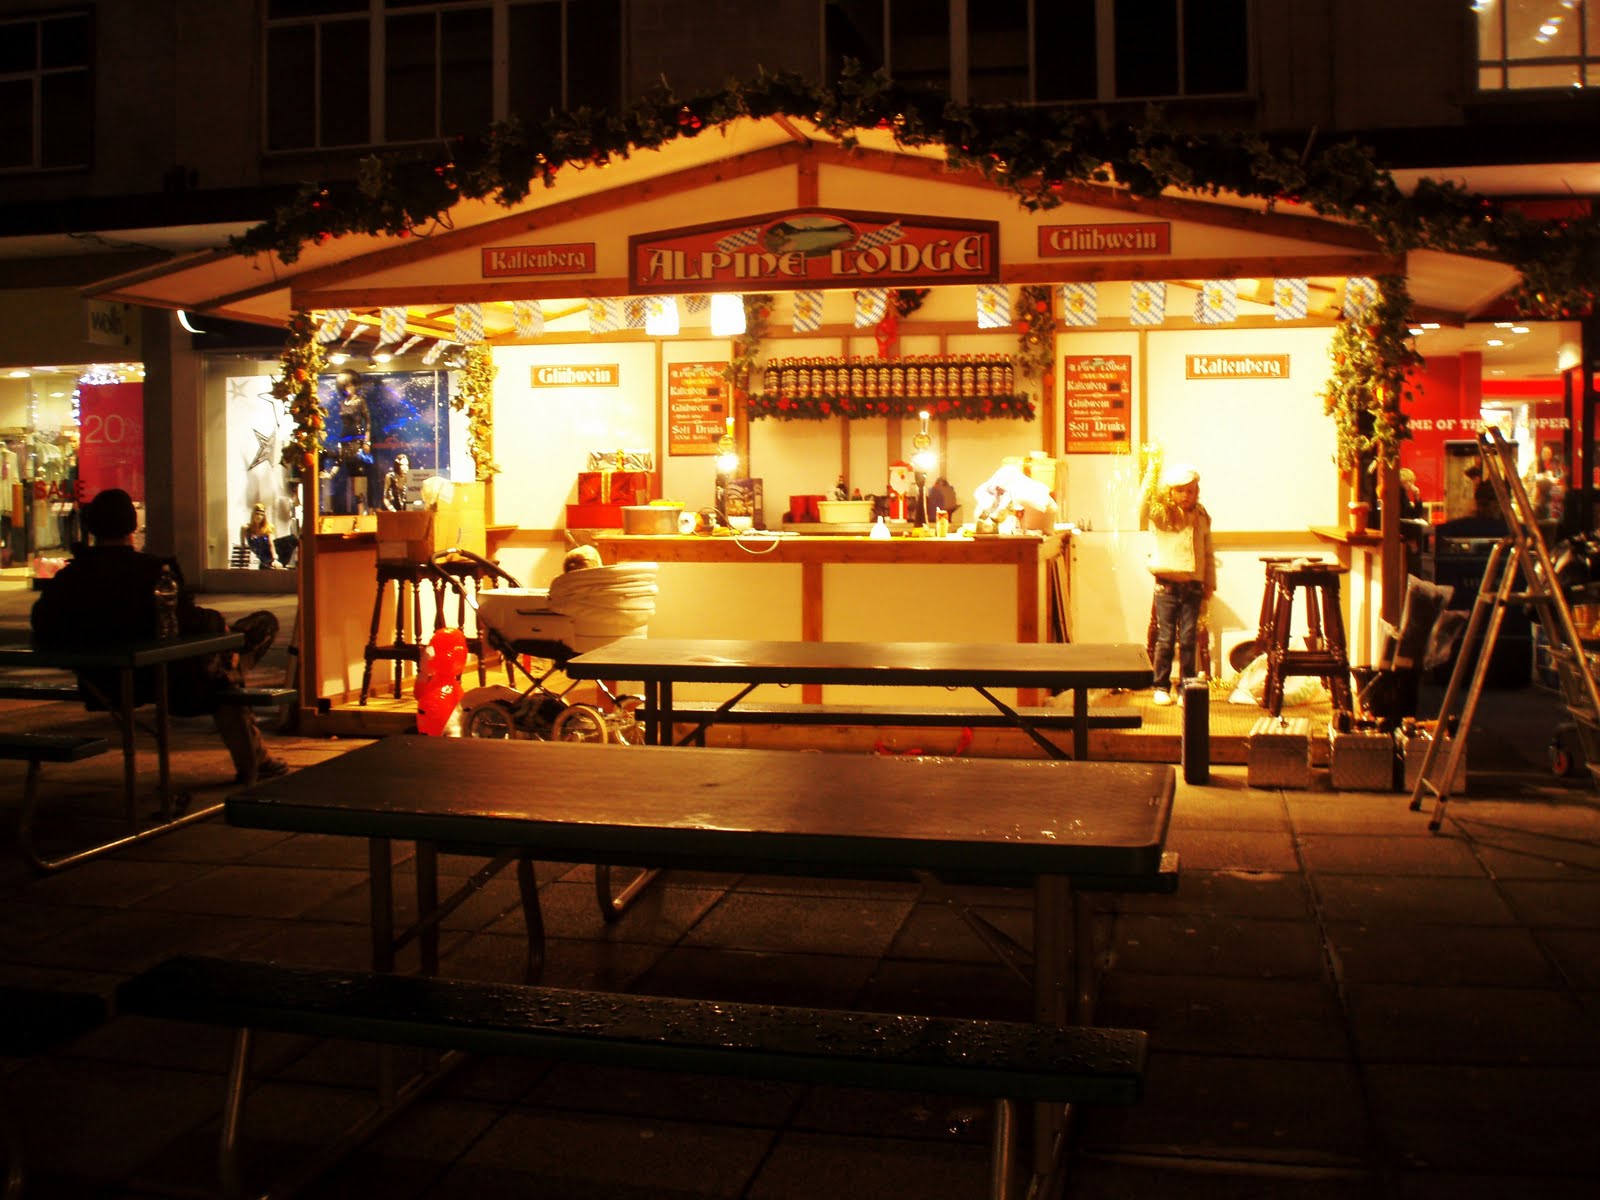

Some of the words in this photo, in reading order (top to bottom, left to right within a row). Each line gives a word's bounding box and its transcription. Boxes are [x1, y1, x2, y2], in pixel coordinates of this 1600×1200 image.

[1049, 229, 1157, 251] Glühwein
[491, 251, 586, 270] Kaltenberg
[643, 248, 807, 281] ALPINE
[831, 234, 985, 275] LODGE
[1193, 357, 1281, 376] Kaltenberg
[538, 367, 611, 384] Glühwein
[1067, 380, 1107, 391] Kaltenberg
[695, 425, 724, 434] Drinks
[1094, 421, 1126, 431] Drinks
[1436, 418, 1457, 430] OF
